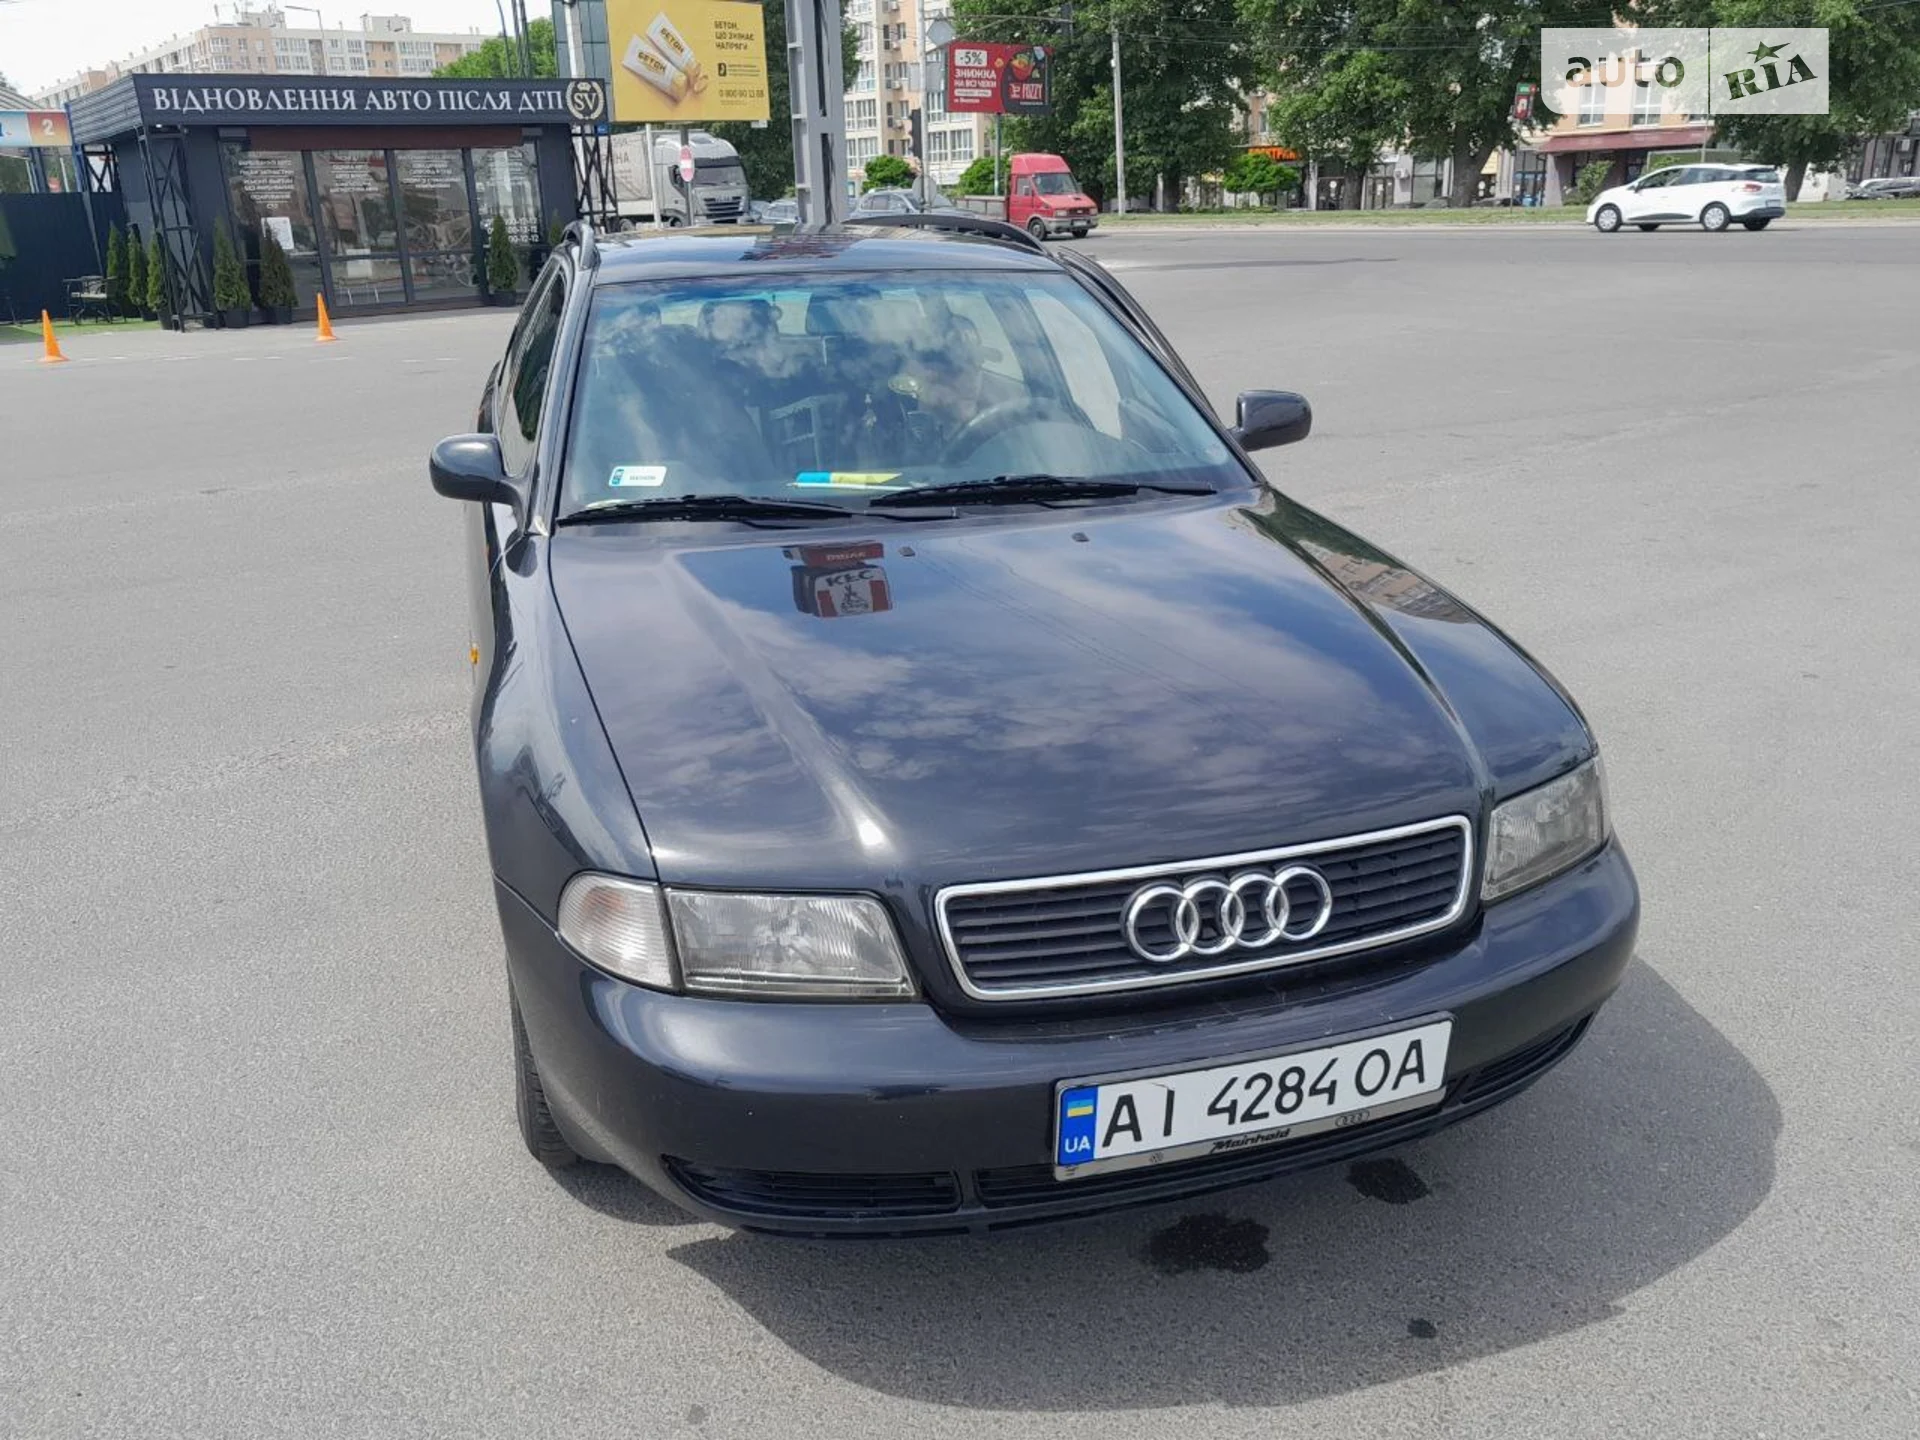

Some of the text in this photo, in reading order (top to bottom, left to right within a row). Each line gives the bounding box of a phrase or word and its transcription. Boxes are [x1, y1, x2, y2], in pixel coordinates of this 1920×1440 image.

[660, 27, 685, 53] БЕТОН
[638, 51, 667, 72] БЕТОН
[960, 51, 983, 65] -5%
[954, 68, 997, 80] ЗНИЖКА
[152, 87, 564, 115] ВІДНОВЛЕННЯ АВТО ПІСЛЯ ДТП
[574, 91, 598, 112] SV
[42, 118, 55, 136] 2
[1101, 1039, 1425, 1148] AI 4284 OA
[1064, 1135, 1091, 1153] UA
